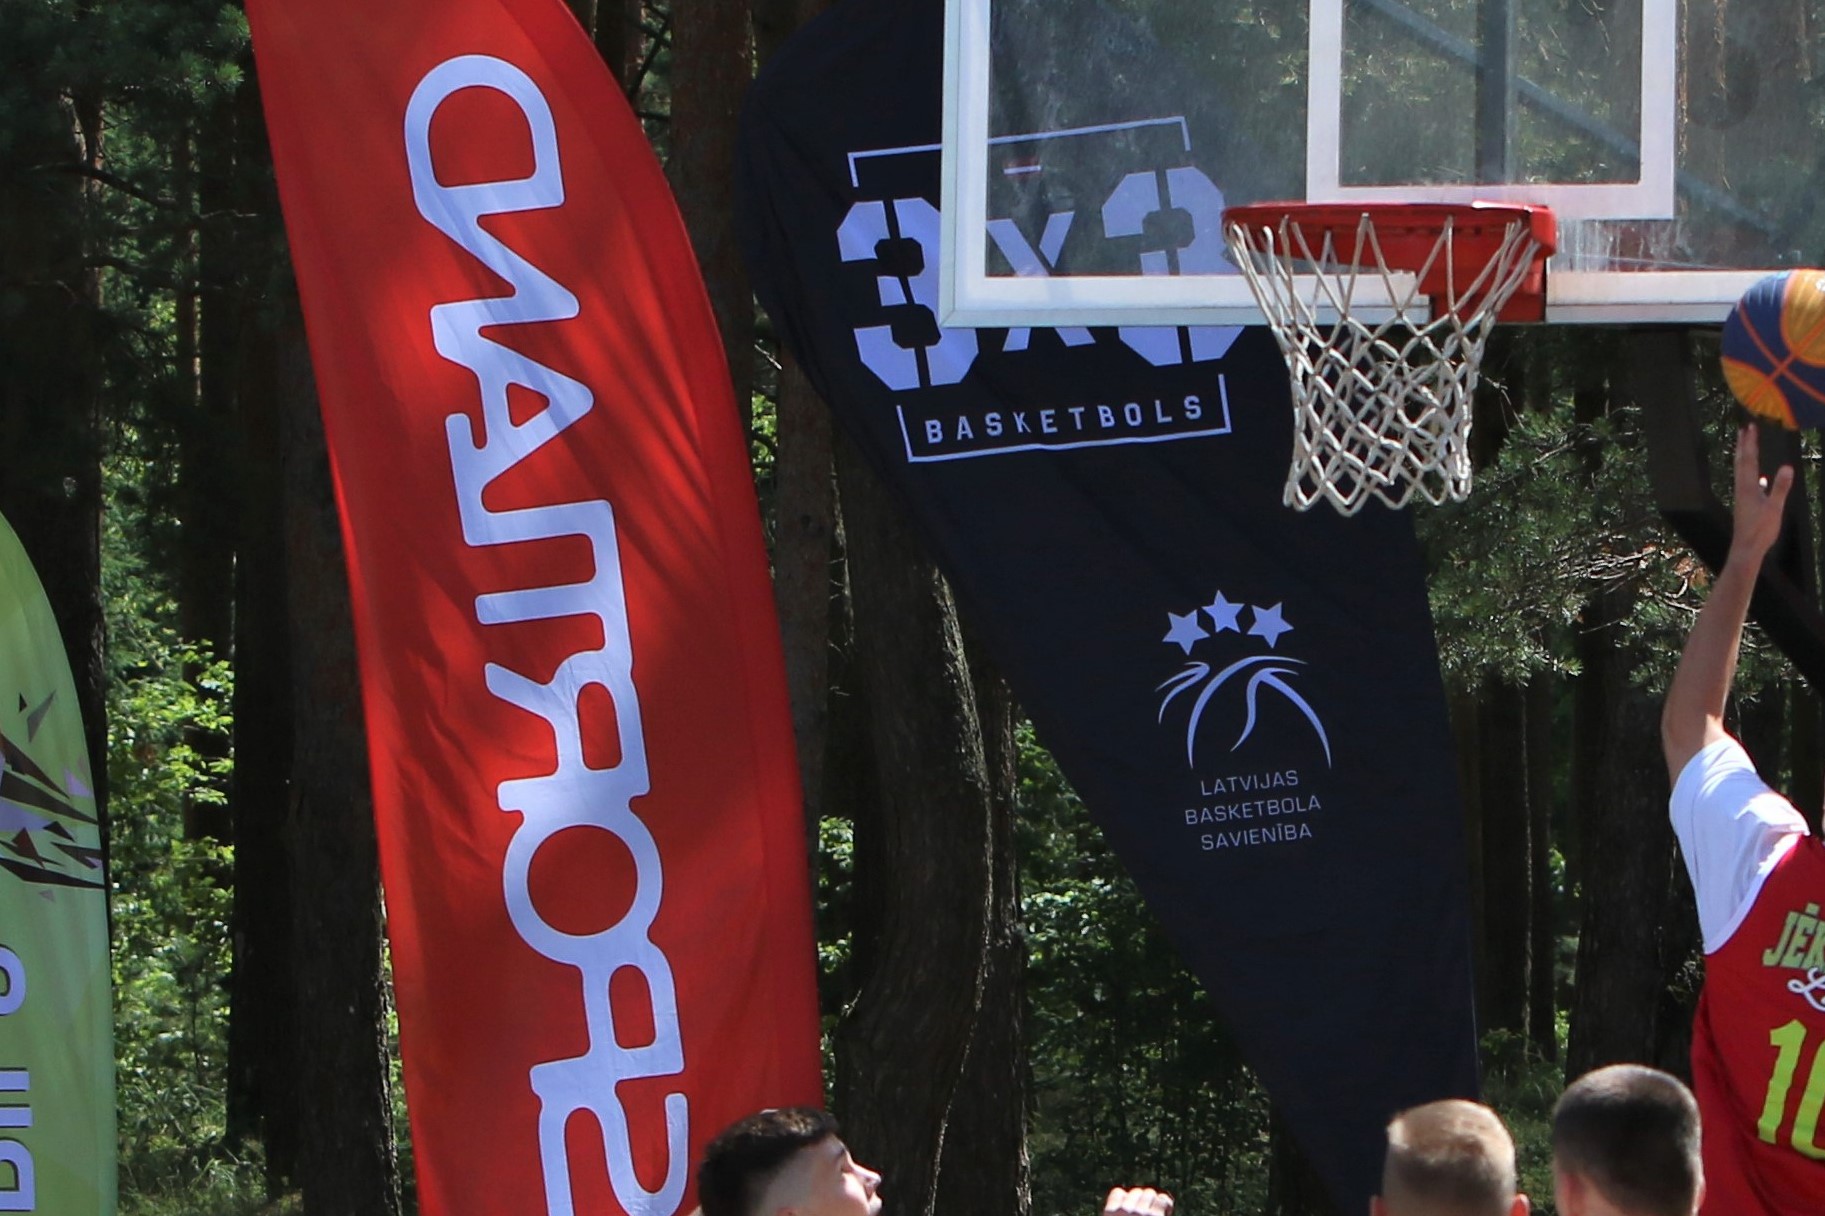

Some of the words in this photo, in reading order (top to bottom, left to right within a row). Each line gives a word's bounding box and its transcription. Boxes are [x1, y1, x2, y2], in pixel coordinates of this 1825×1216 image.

[924, 395, 1203, 444] BASKETBOLS
[1200, 769, 1299, 796] LATVIJAS
[1184, 795, 1322, 825] BASKETBOLA
[1200, 823, 1312, 850] SAVIENĪBA
